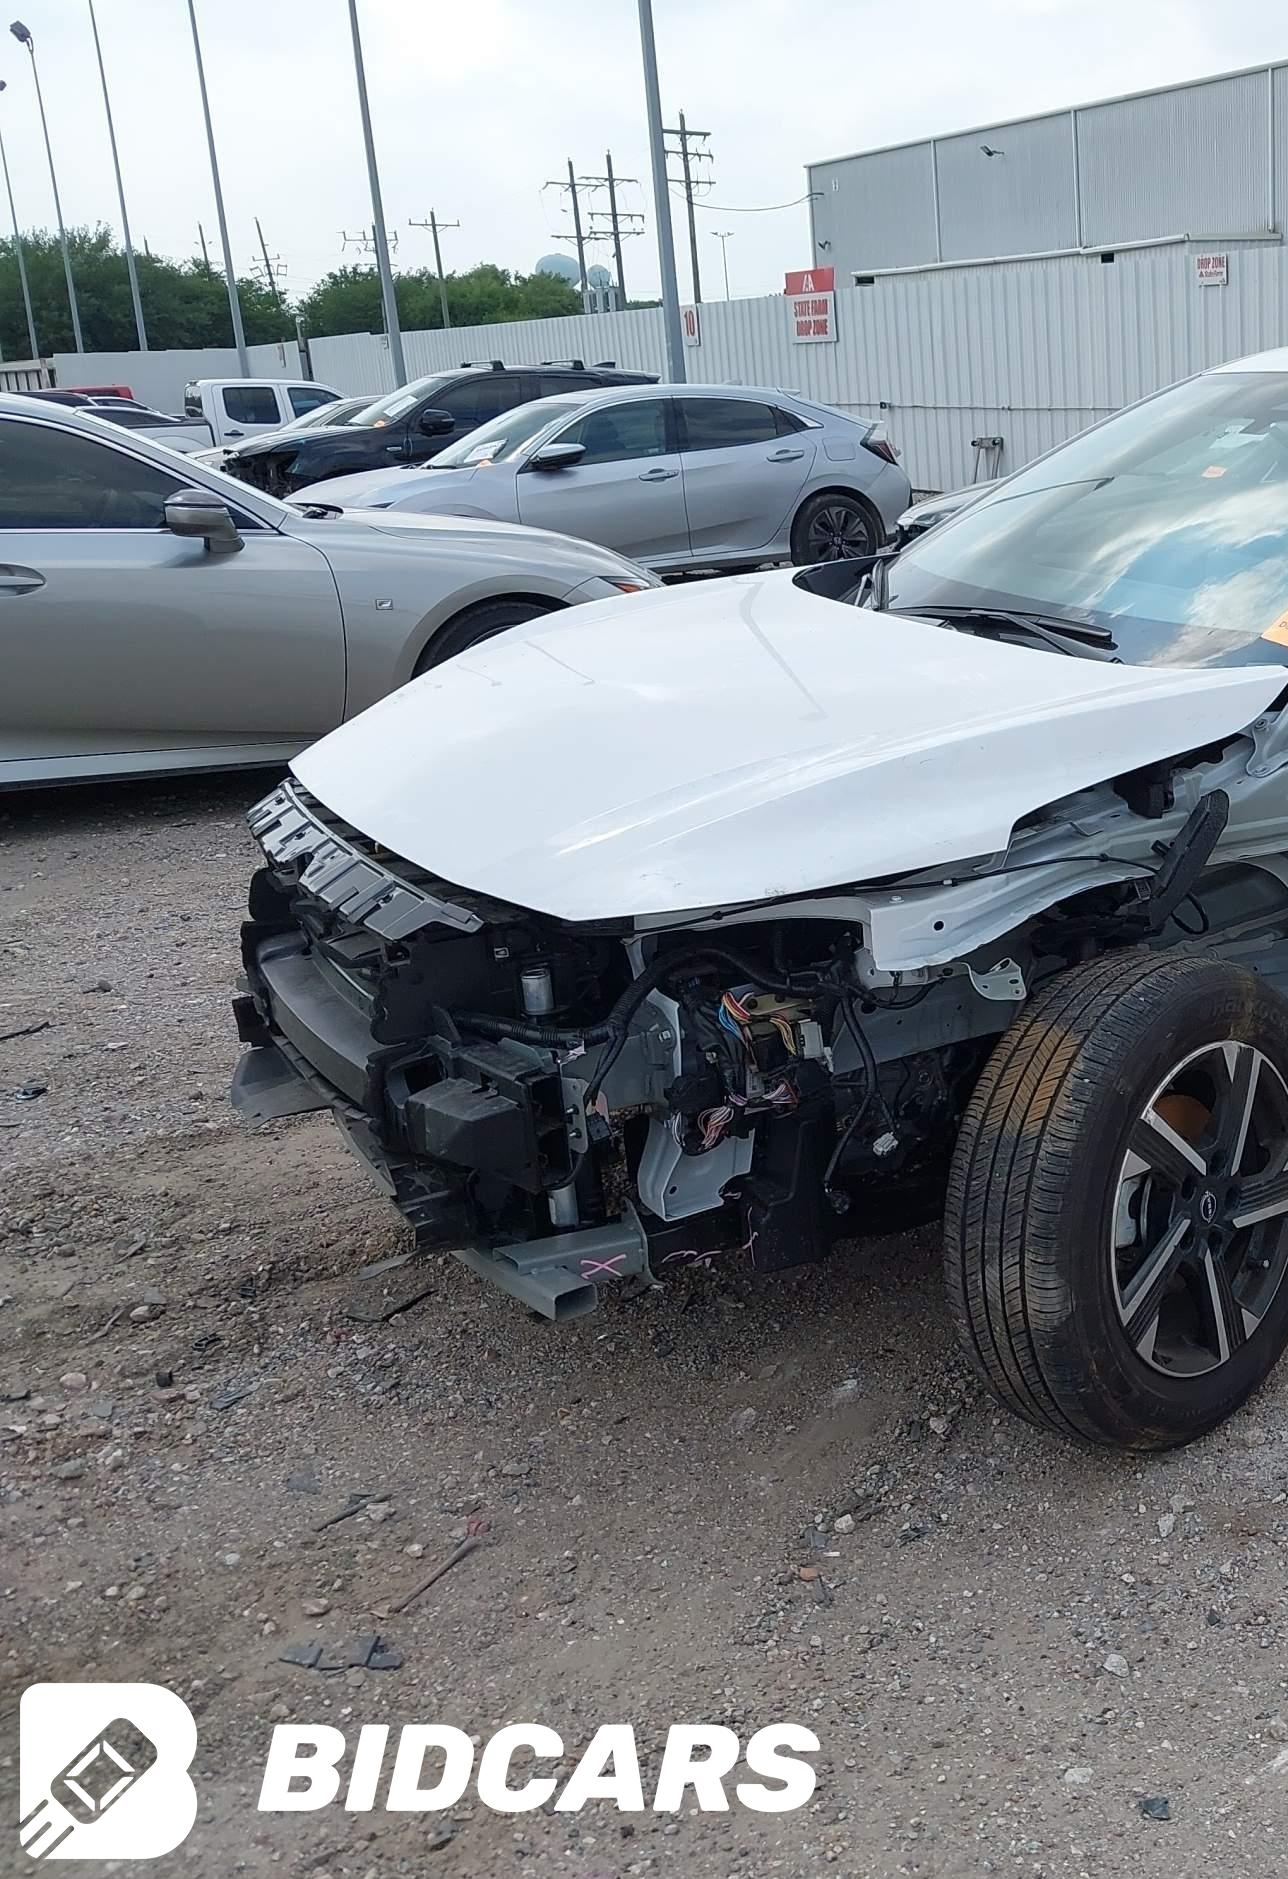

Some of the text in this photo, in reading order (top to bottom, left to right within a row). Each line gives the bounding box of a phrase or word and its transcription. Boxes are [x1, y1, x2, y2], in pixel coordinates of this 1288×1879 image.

[1197, 256, 1225, 269] DROP ZONE
[793, 298, 828, 318] STATE FARM
[683, 310, 696, 336] 10
[796, 319, 828, 336] DROP ZONE
